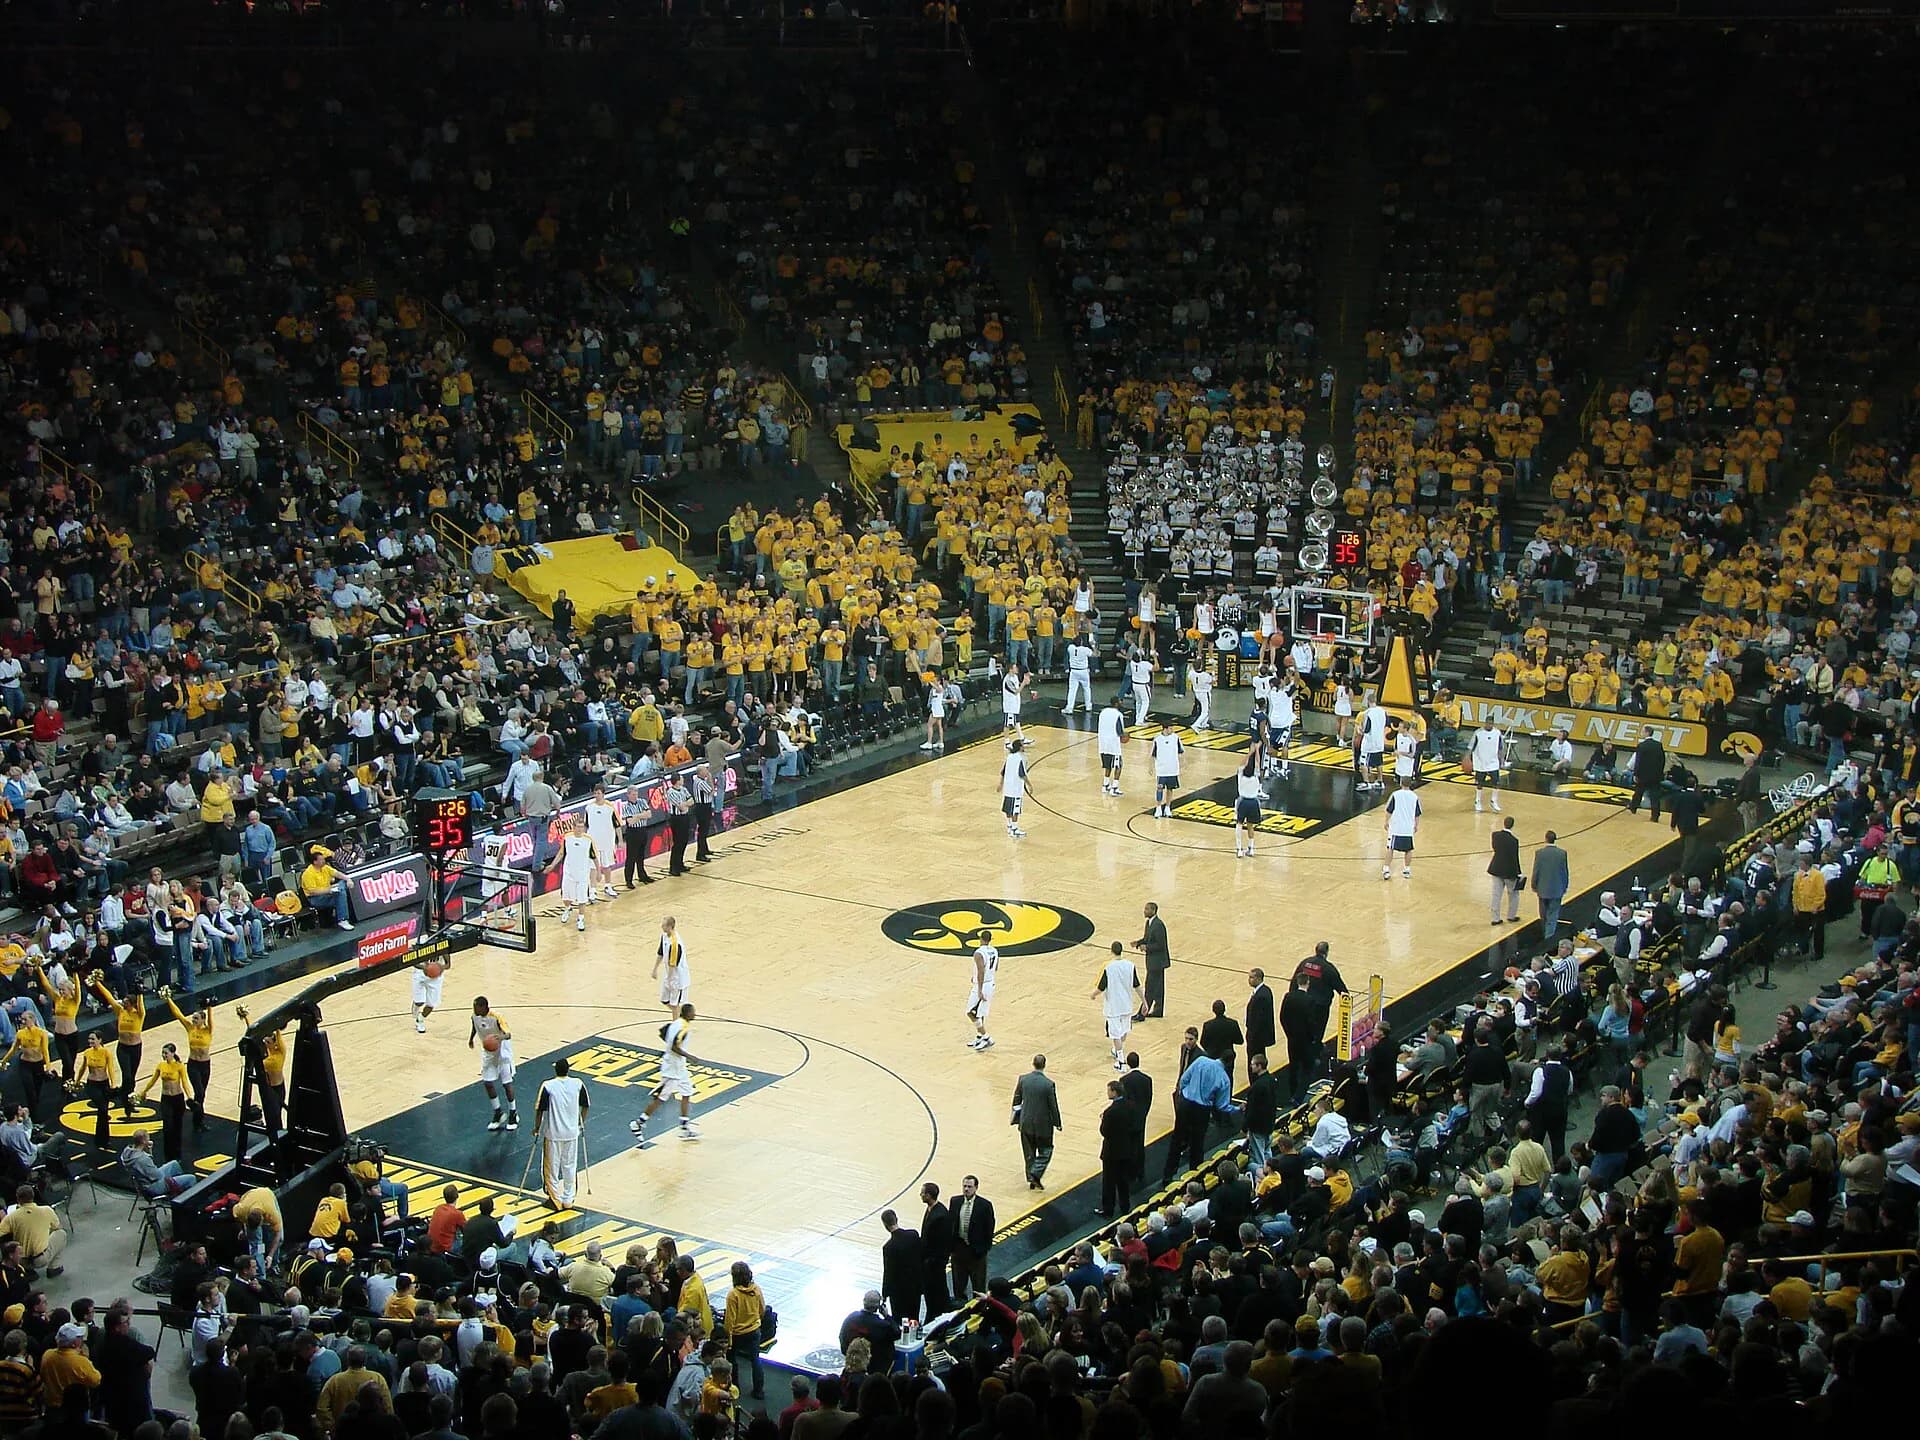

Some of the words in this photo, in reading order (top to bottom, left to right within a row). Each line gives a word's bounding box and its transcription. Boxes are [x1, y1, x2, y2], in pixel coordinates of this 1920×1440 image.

[1341, 534, 1360, 545] 1:26
[1335, 544, 1357, 563] 35
[1460, 700, 1575, 734] AWK'S
[438, 800, 467, 817] 1:26
[429, 817, 463, 847] 35
[486, 845, 500, 858] 30
[567, 1048, 661, 1089] TEN
